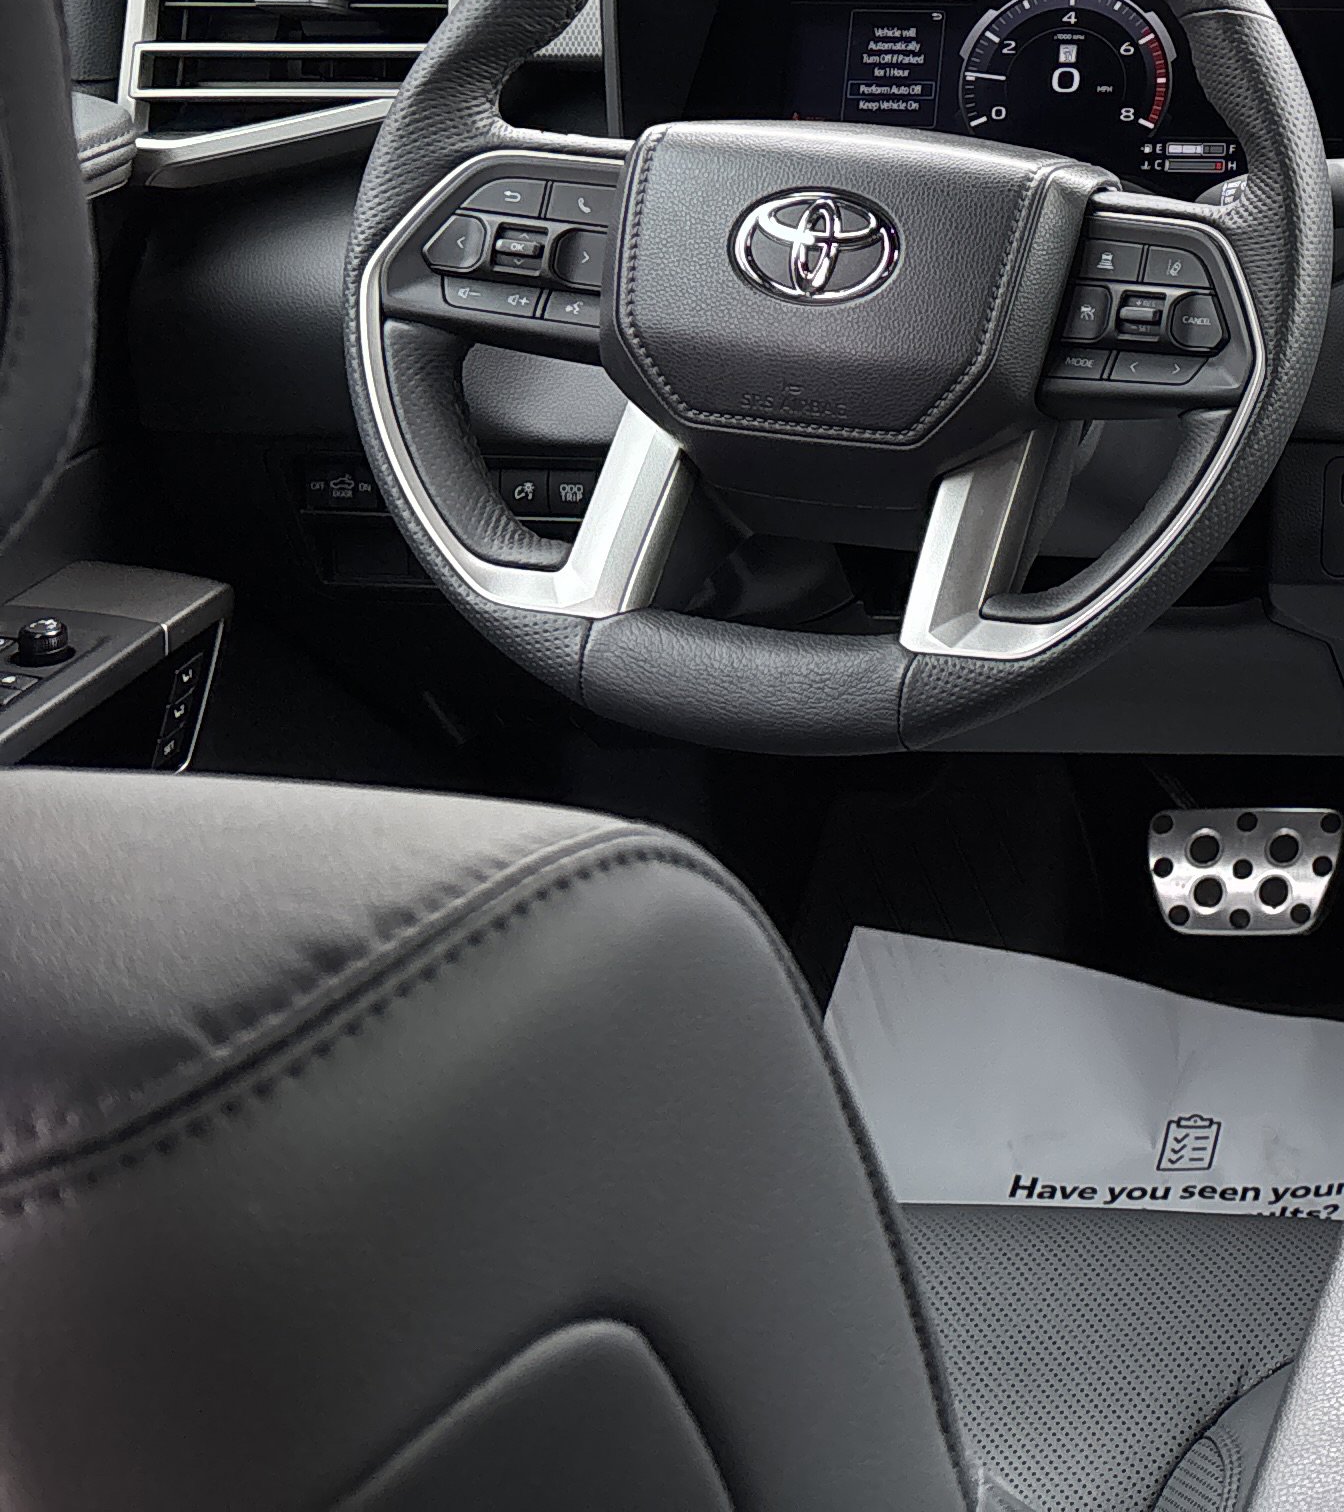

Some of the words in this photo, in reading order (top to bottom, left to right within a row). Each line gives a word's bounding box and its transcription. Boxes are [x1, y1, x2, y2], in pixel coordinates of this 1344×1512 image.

[1061, 11, 1078, 25] 4
[874, 27, 902, 38] Vehicle
[902, 28, 917, 38] will
[867, 40, 921, 52] Automatically
[1001, 40, 1017, 54] 2
[1119, 41, 1135, 56] 6
[862, 53, 880, 64] Turn
[880, 53, 892, 64] Off
[898, 54, 925, 64] Parked
[874, 67, 885, 77] for
[890, 68, 910, 77] Hour
[1051, 67, 1081, 93] 0
[859, 84, 890, 95] Perform
[890, 85, 909, 95] Auto
[910, 85, 923, 95] Off
[1096, 85, 1113, 93] MPH
[858, 100, 880, 112] Keep
[880, 99, 907, 111] Vehicle
[907, 100, 920, 111] On
[991, 106, 1007, 120] 0
[1119, 107, 1135, 121] 8
[1155, 143, 1163, 154] E
[1228, 144, 1237, 155] F
[1154, 159, 1162, 170] C
[1227, 160, 1237, 171] H
[510, 242, 525, 252] OK
[1182, 315, 1212, 326] CANCEL
[1064, 356, 1095, 368] MODE
[1007, 1174, 1099, 1202] Have
[1102, 1183, 1172, 1205] you
[1178, 1181, 1262, 1203] seen
